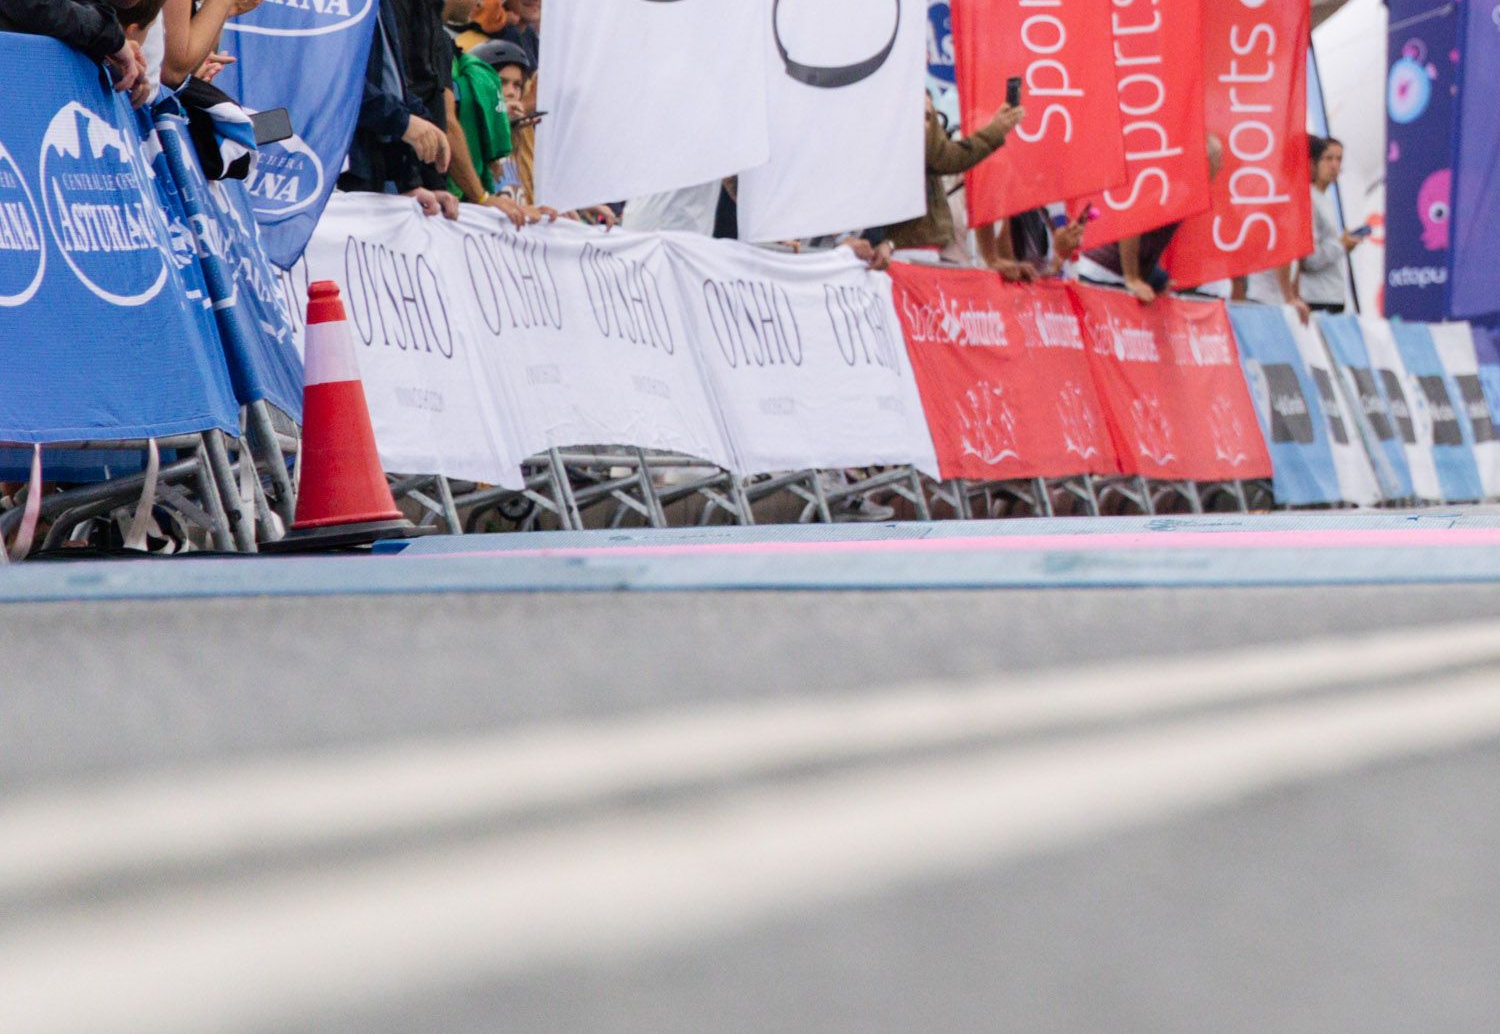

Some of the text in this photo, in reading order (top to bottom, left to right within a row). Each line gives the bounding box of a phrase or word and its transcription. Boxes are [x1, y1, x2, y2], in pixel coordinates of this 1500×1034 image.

[345, 235, 453, 359] OYSHO
[463, 233, 562, 336] OYSHO
[579, 241, 674, 356] OYSHO
[703, 278, 803, 369] OYSHO
